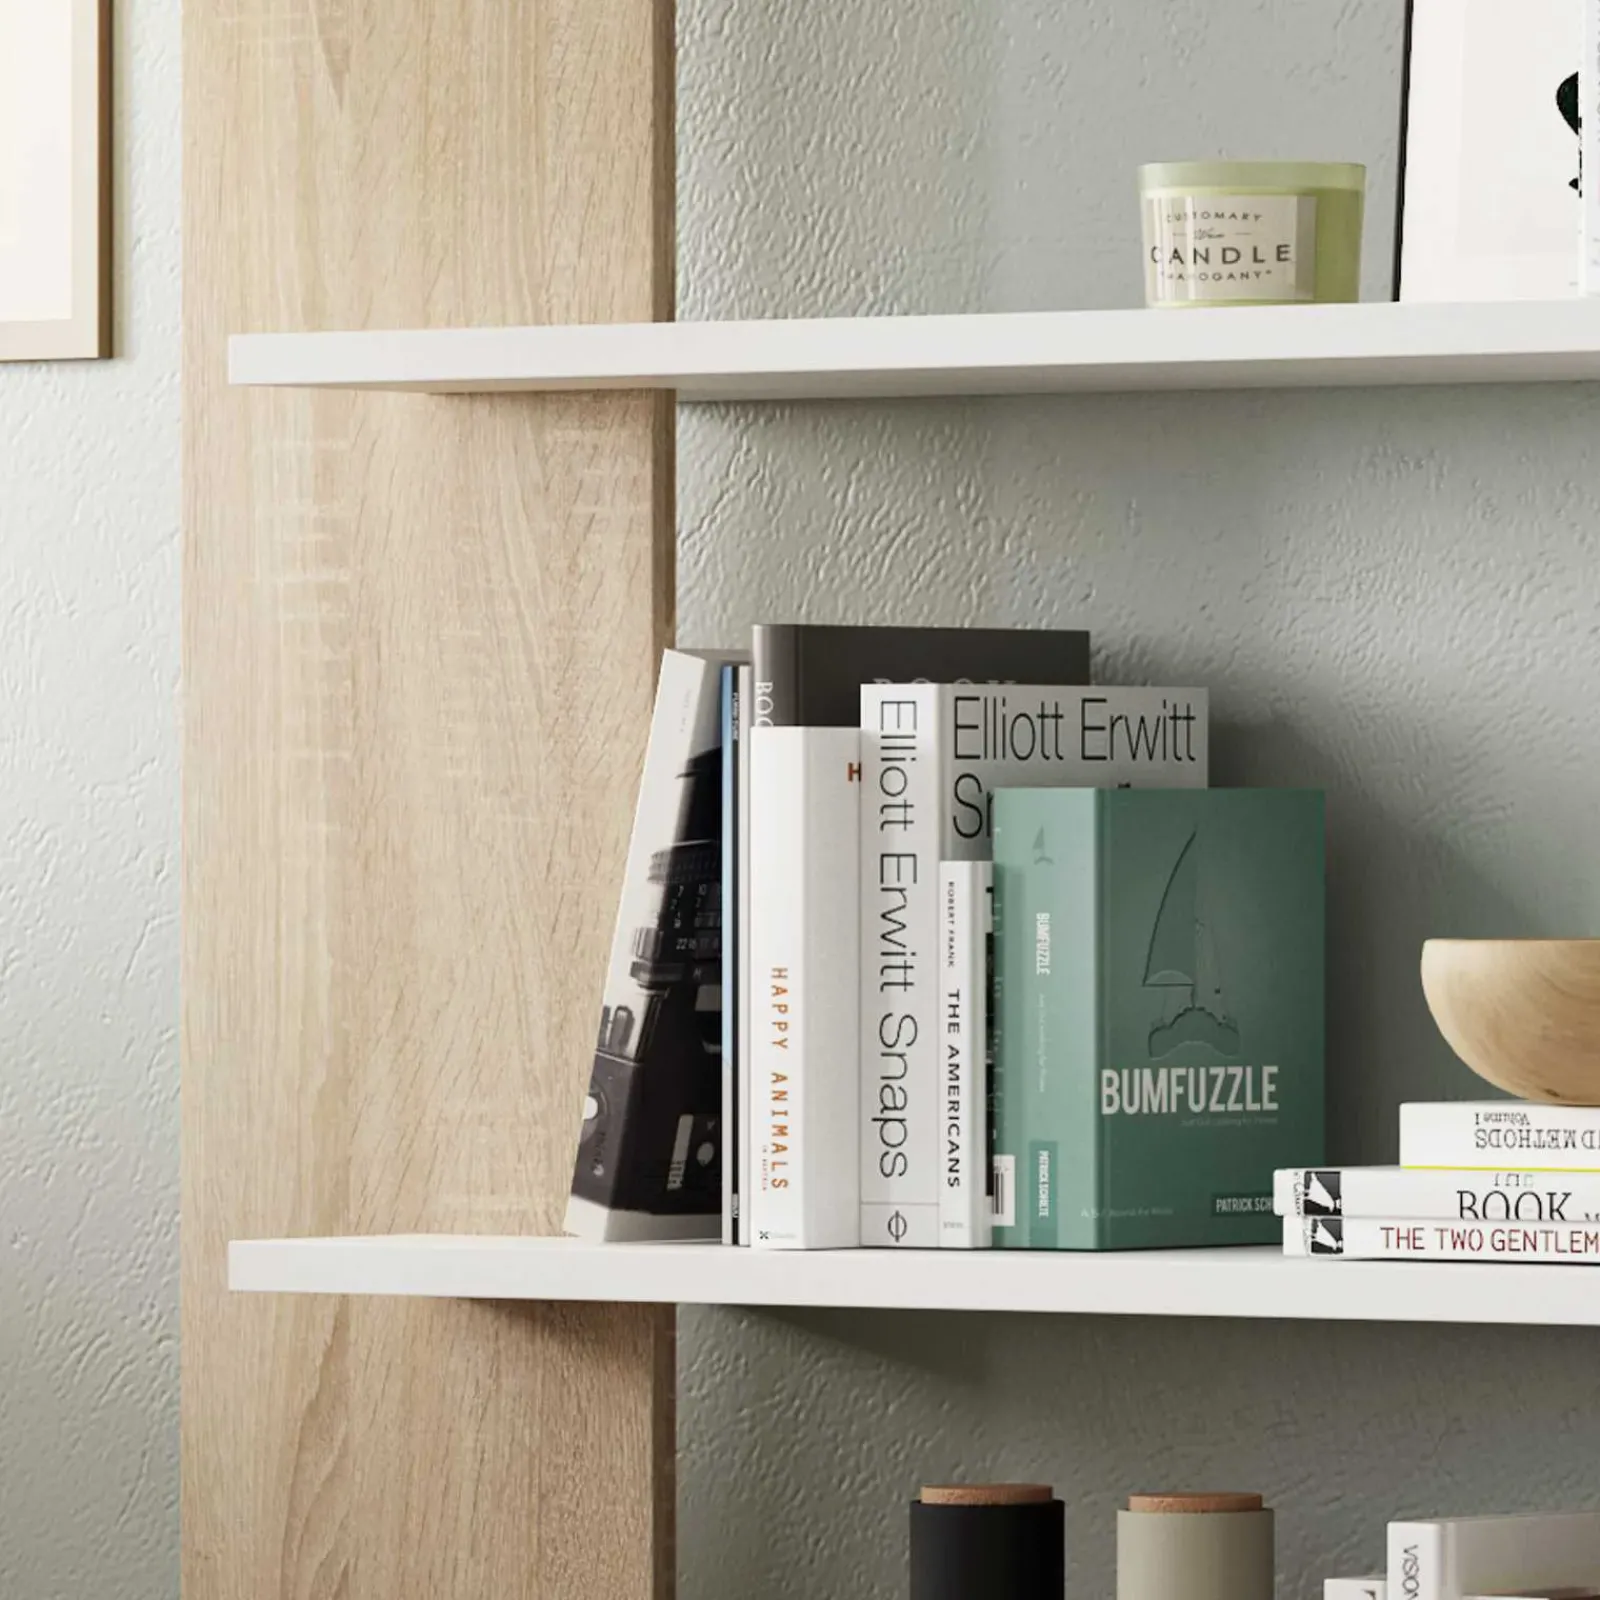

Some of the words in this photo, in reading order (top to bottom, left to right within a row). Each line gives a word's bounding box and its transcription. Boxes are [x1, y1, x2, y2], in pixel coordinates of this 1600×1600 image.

[1150, 244, 1291, 266] CANDLE
[954, 697, 1065, 761] Elliott
[1080, 697, 1197, 761] Erwitt
[879, 700, 917, 831] Elliott
[879, 853, 917, 992] Erwitt
[1035, 912, 1051, 976] BUMFUZZLE
[770, 966, 789, 1051] HAPPY
[947, 988, 961, 1034] THE
[871, 1012, 918, 1179] Snaps
[947, 1044, 961, 1188] AMERICANS
[1100, 1065, 1279, 1116] BUMFUZZLE
[770, 1071, 789, 1190] ANIMALS
[1474, 1128, 1577, 1150] METHODS
[1380, 1226, 1426, 1250] THE
[1434, 1227, 1485, 1252] TWO
